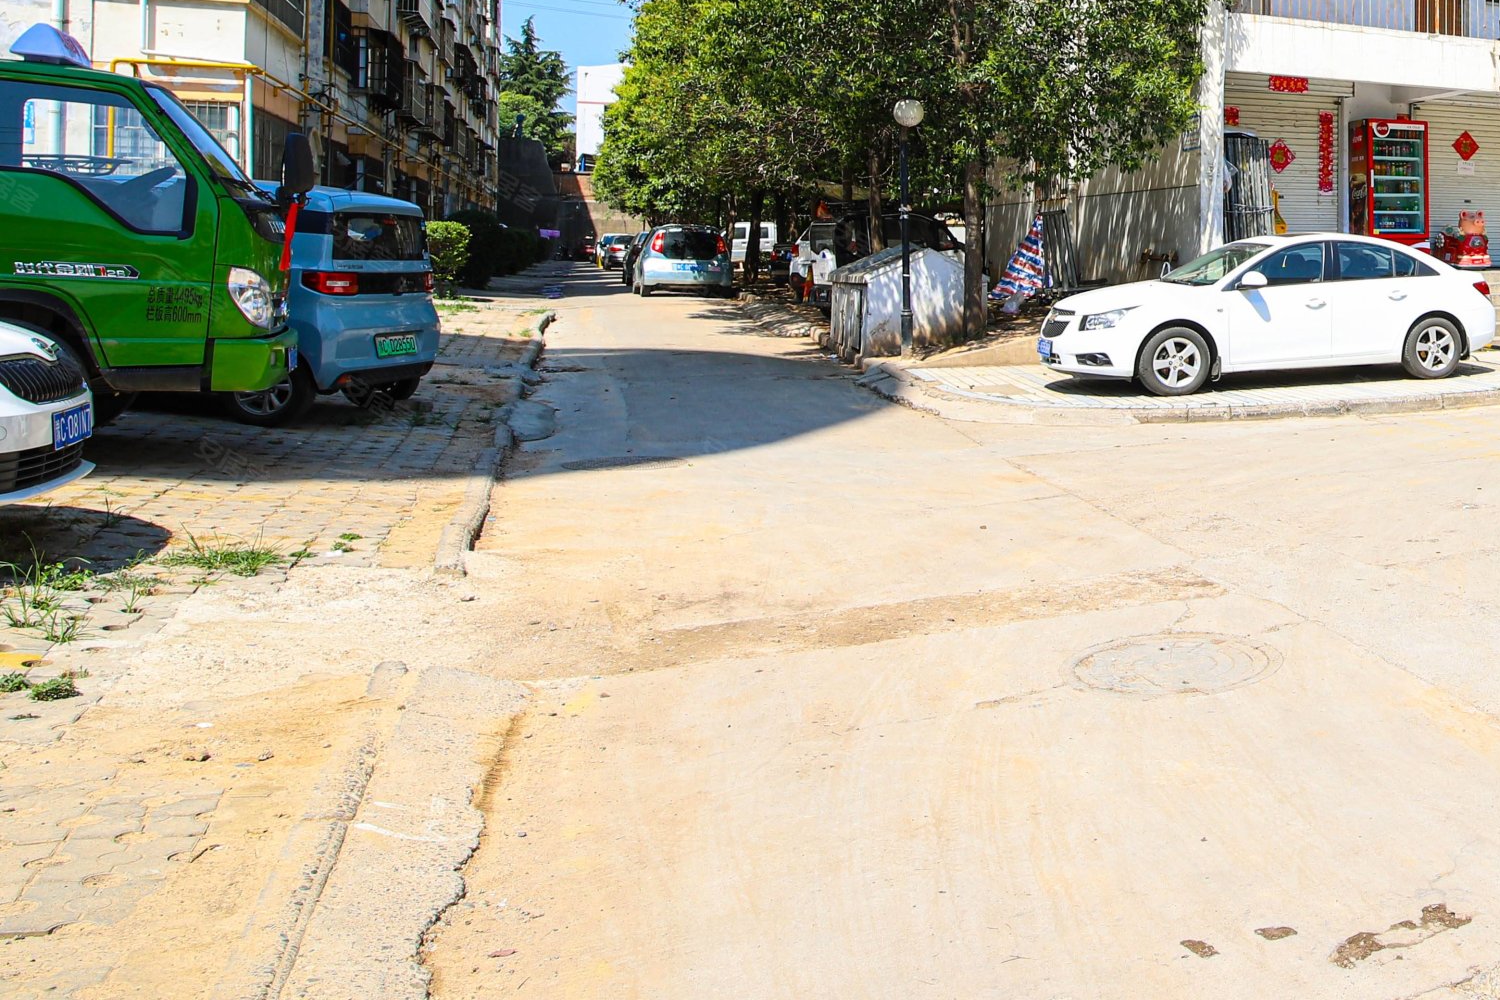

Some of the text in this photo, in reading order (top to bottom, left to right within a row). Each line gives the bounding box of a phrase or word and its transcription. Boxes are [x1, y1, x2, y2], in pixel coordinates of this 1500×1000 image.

[147, 286, 204, 308] 总质量4495kg
[146, 305, 202, 323] 栏板高600mm
